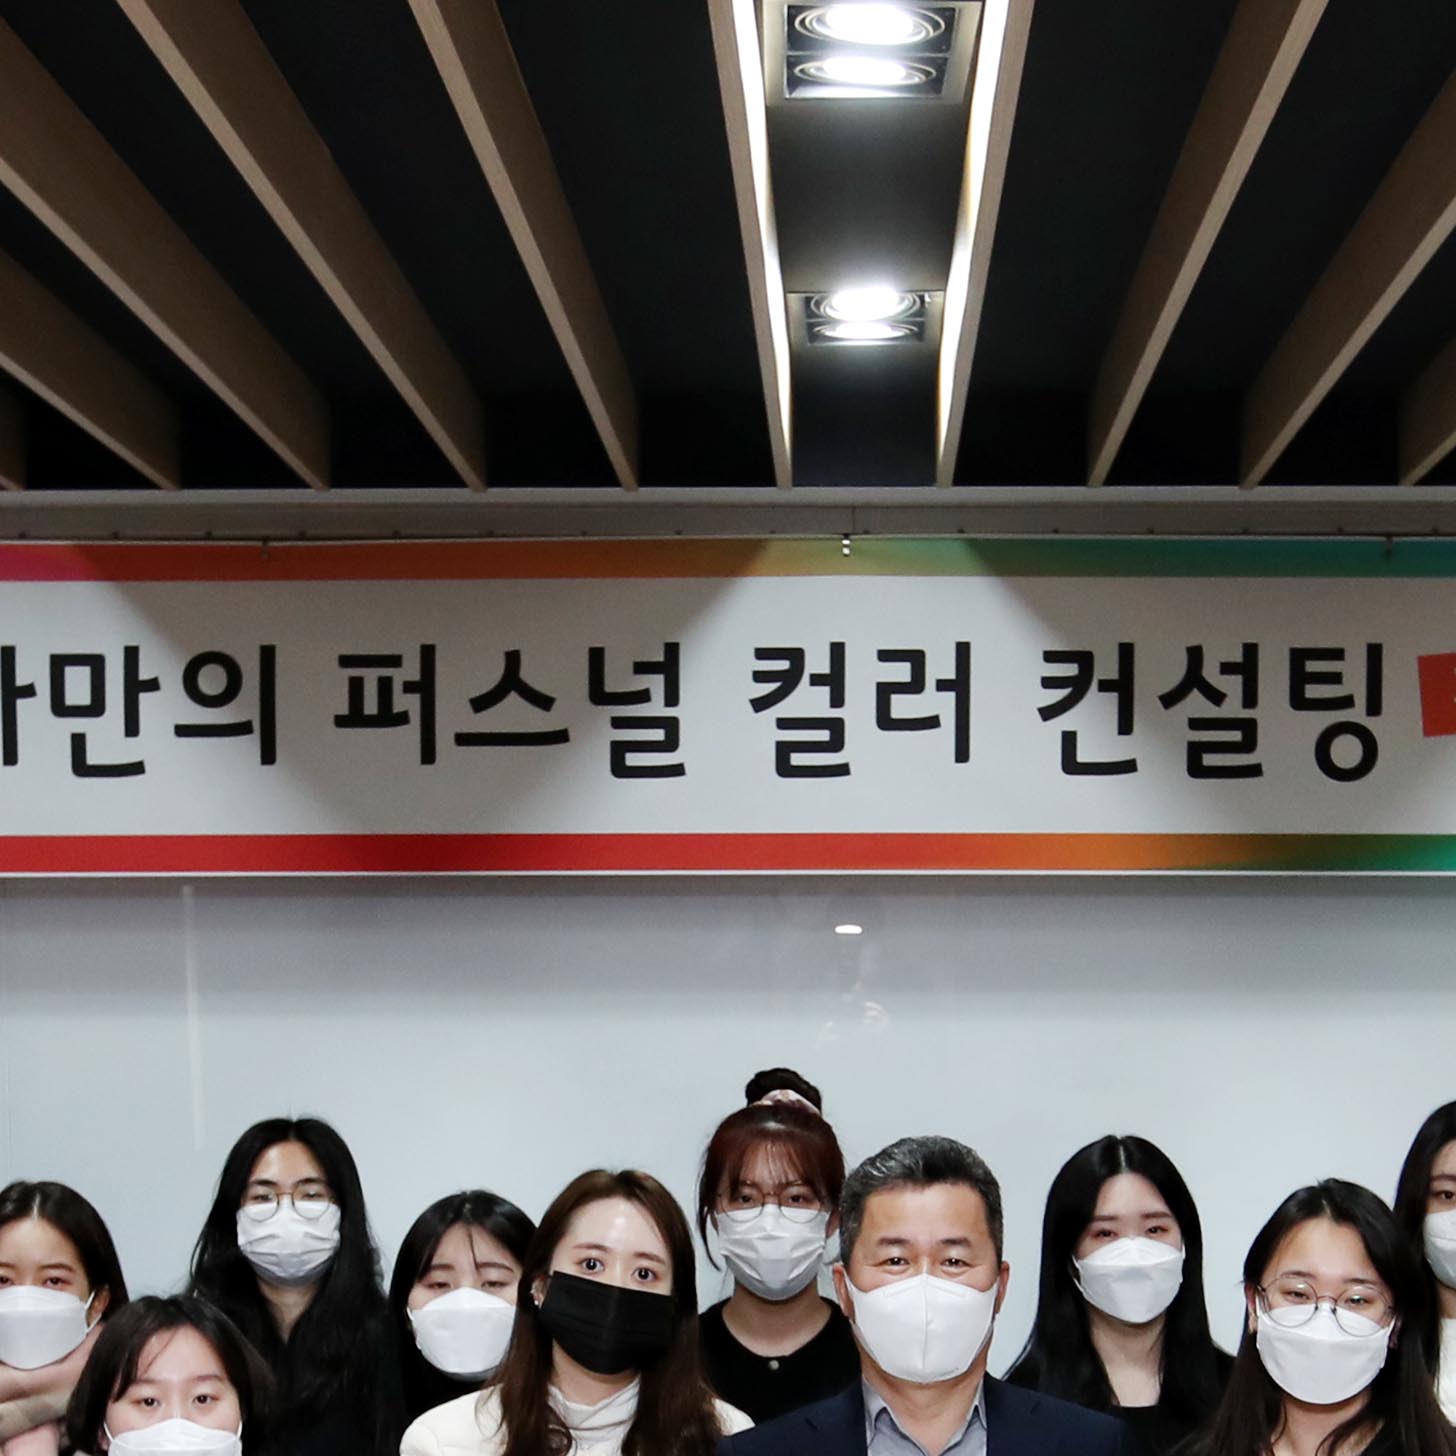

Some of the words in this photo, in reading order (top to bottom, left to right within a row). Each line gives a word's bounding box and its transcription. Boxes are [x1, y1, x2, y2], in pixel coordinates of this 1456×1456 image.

[333, 641, 686, 779] 퍼스널
[747, 640, 971, 780] 컬러
[1036, 640, 1384, 783] 컨설팅
